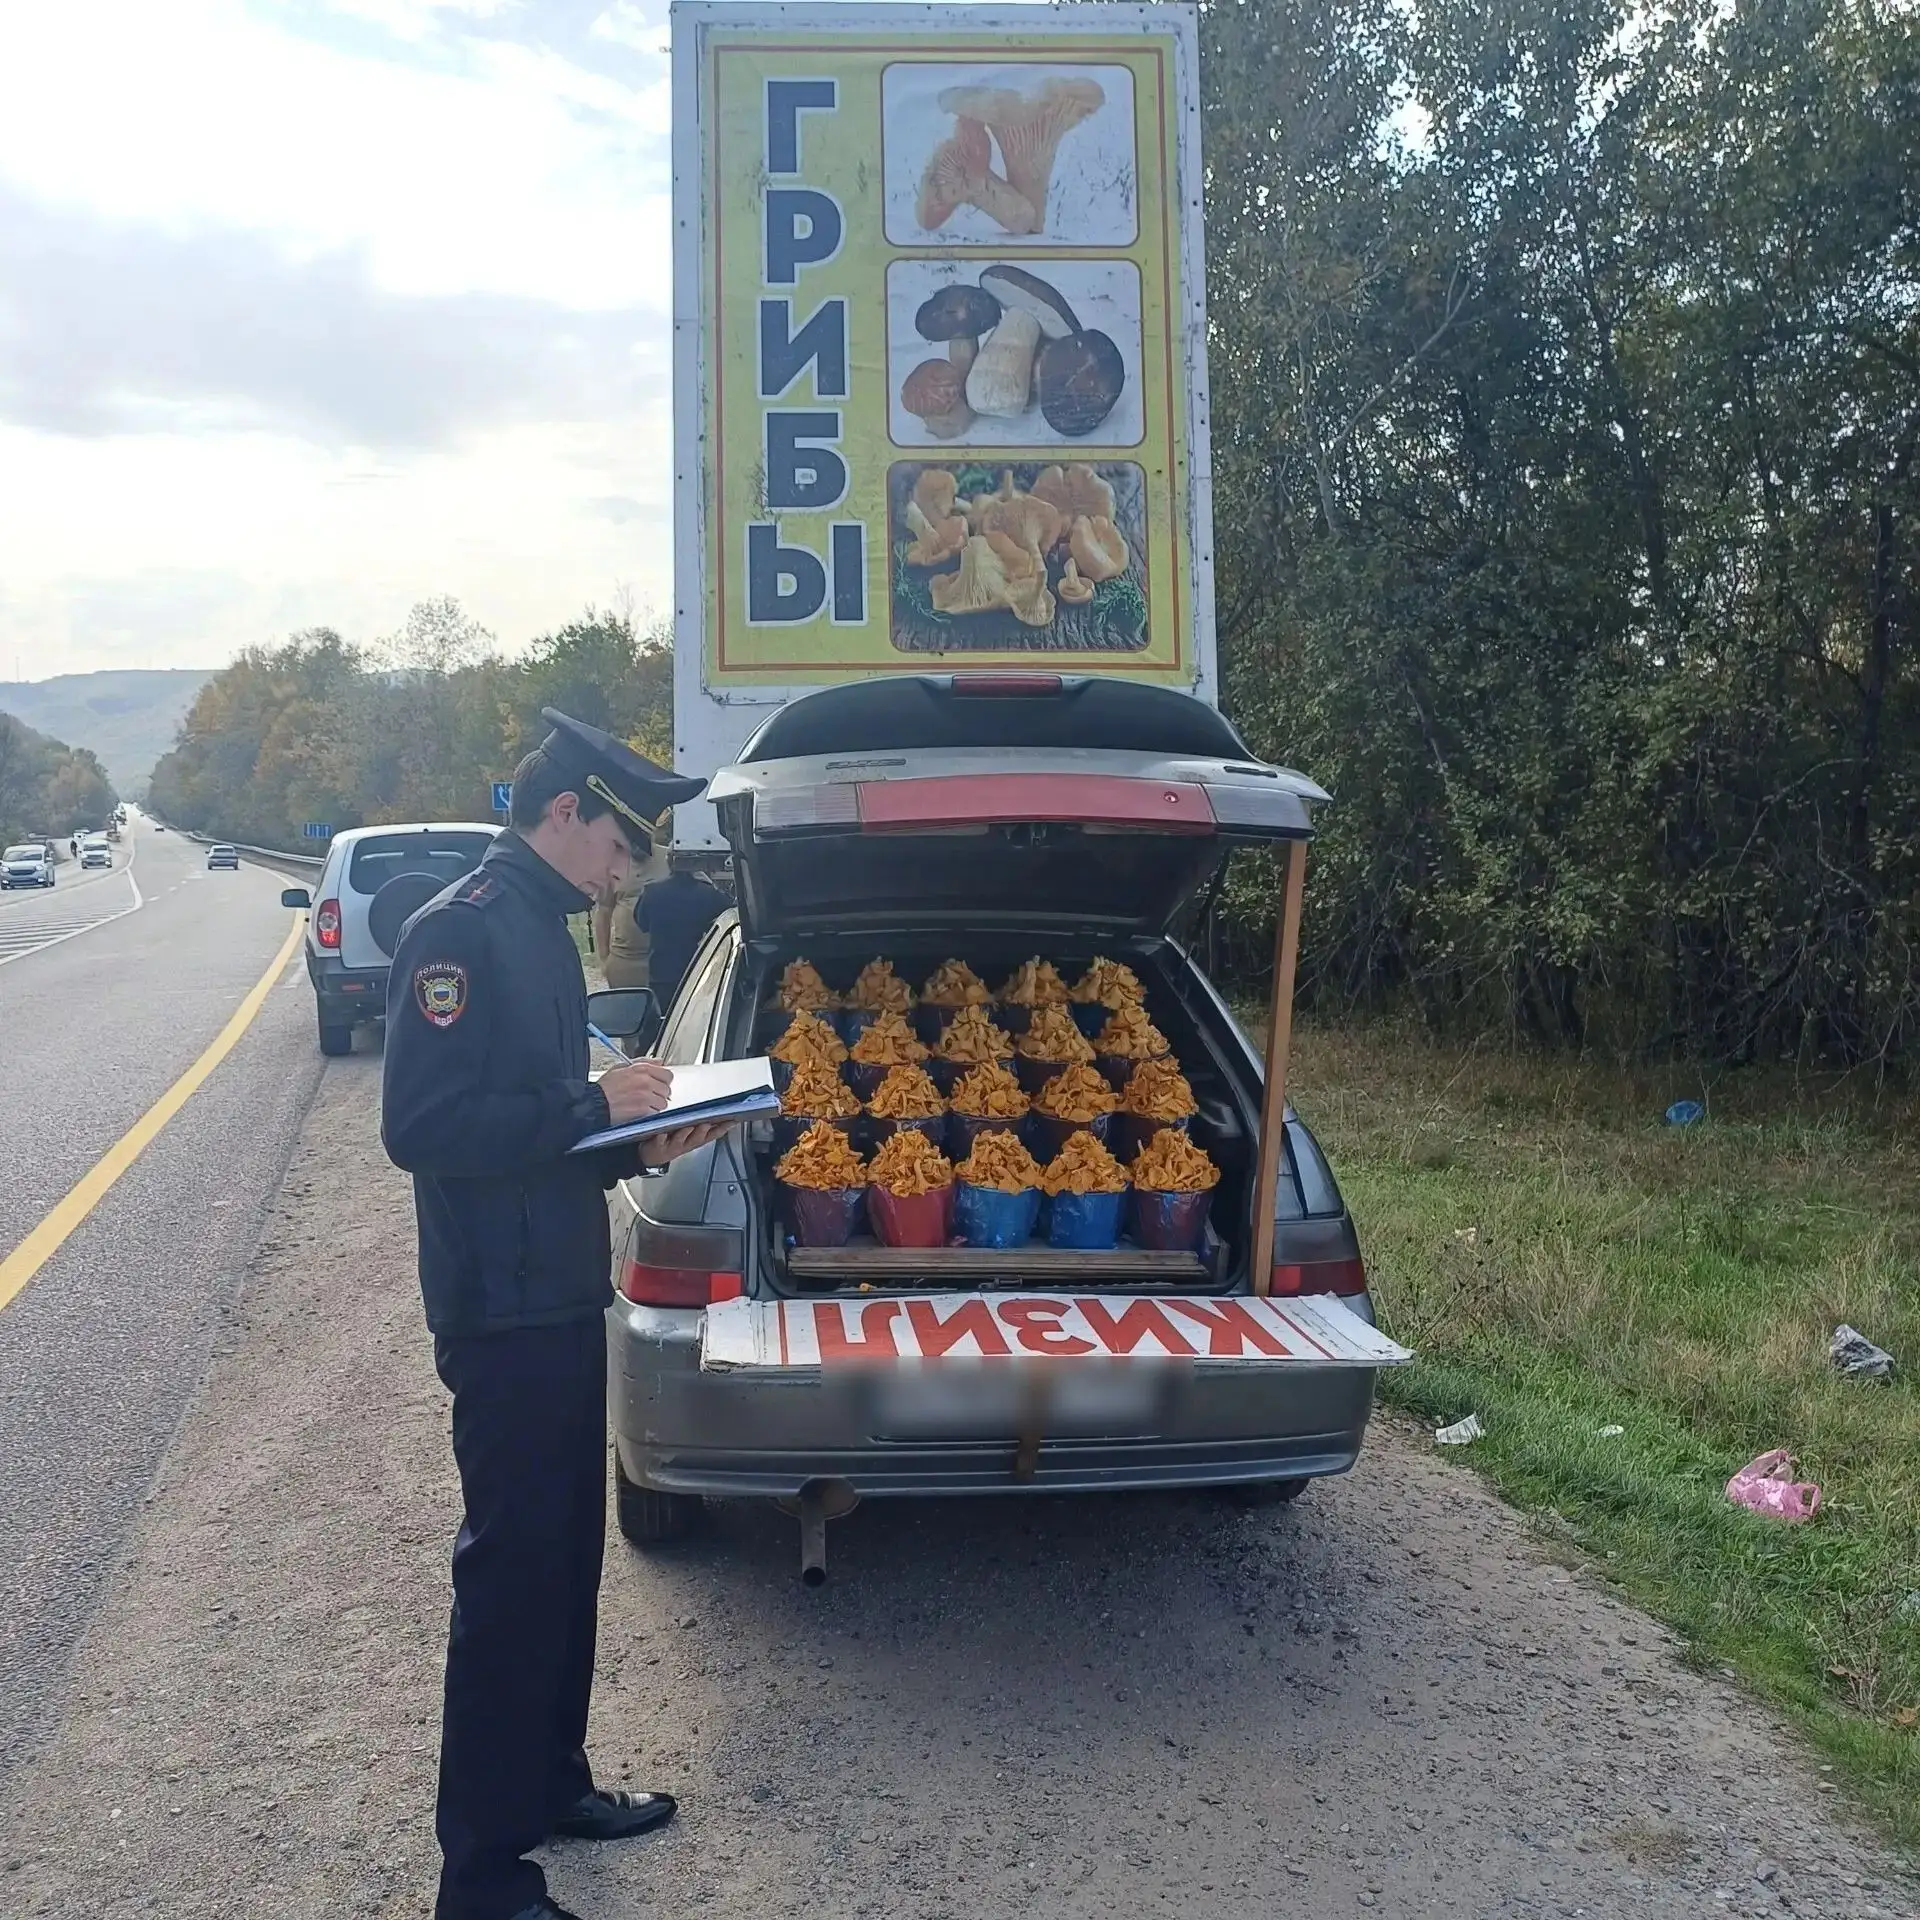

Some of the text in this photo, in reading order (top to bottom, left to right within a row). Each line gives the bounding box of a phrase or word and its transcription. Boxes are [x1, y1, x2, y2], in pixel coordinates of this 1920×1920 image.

[748, 80, 863, 622] ГРИБЫ
[417, 963, 463, 979] ПОЛИЦИЯ
[434, 1014, 453, 1027] МВД
[812, 1298, 1294, 1358] КИЗИЛ
